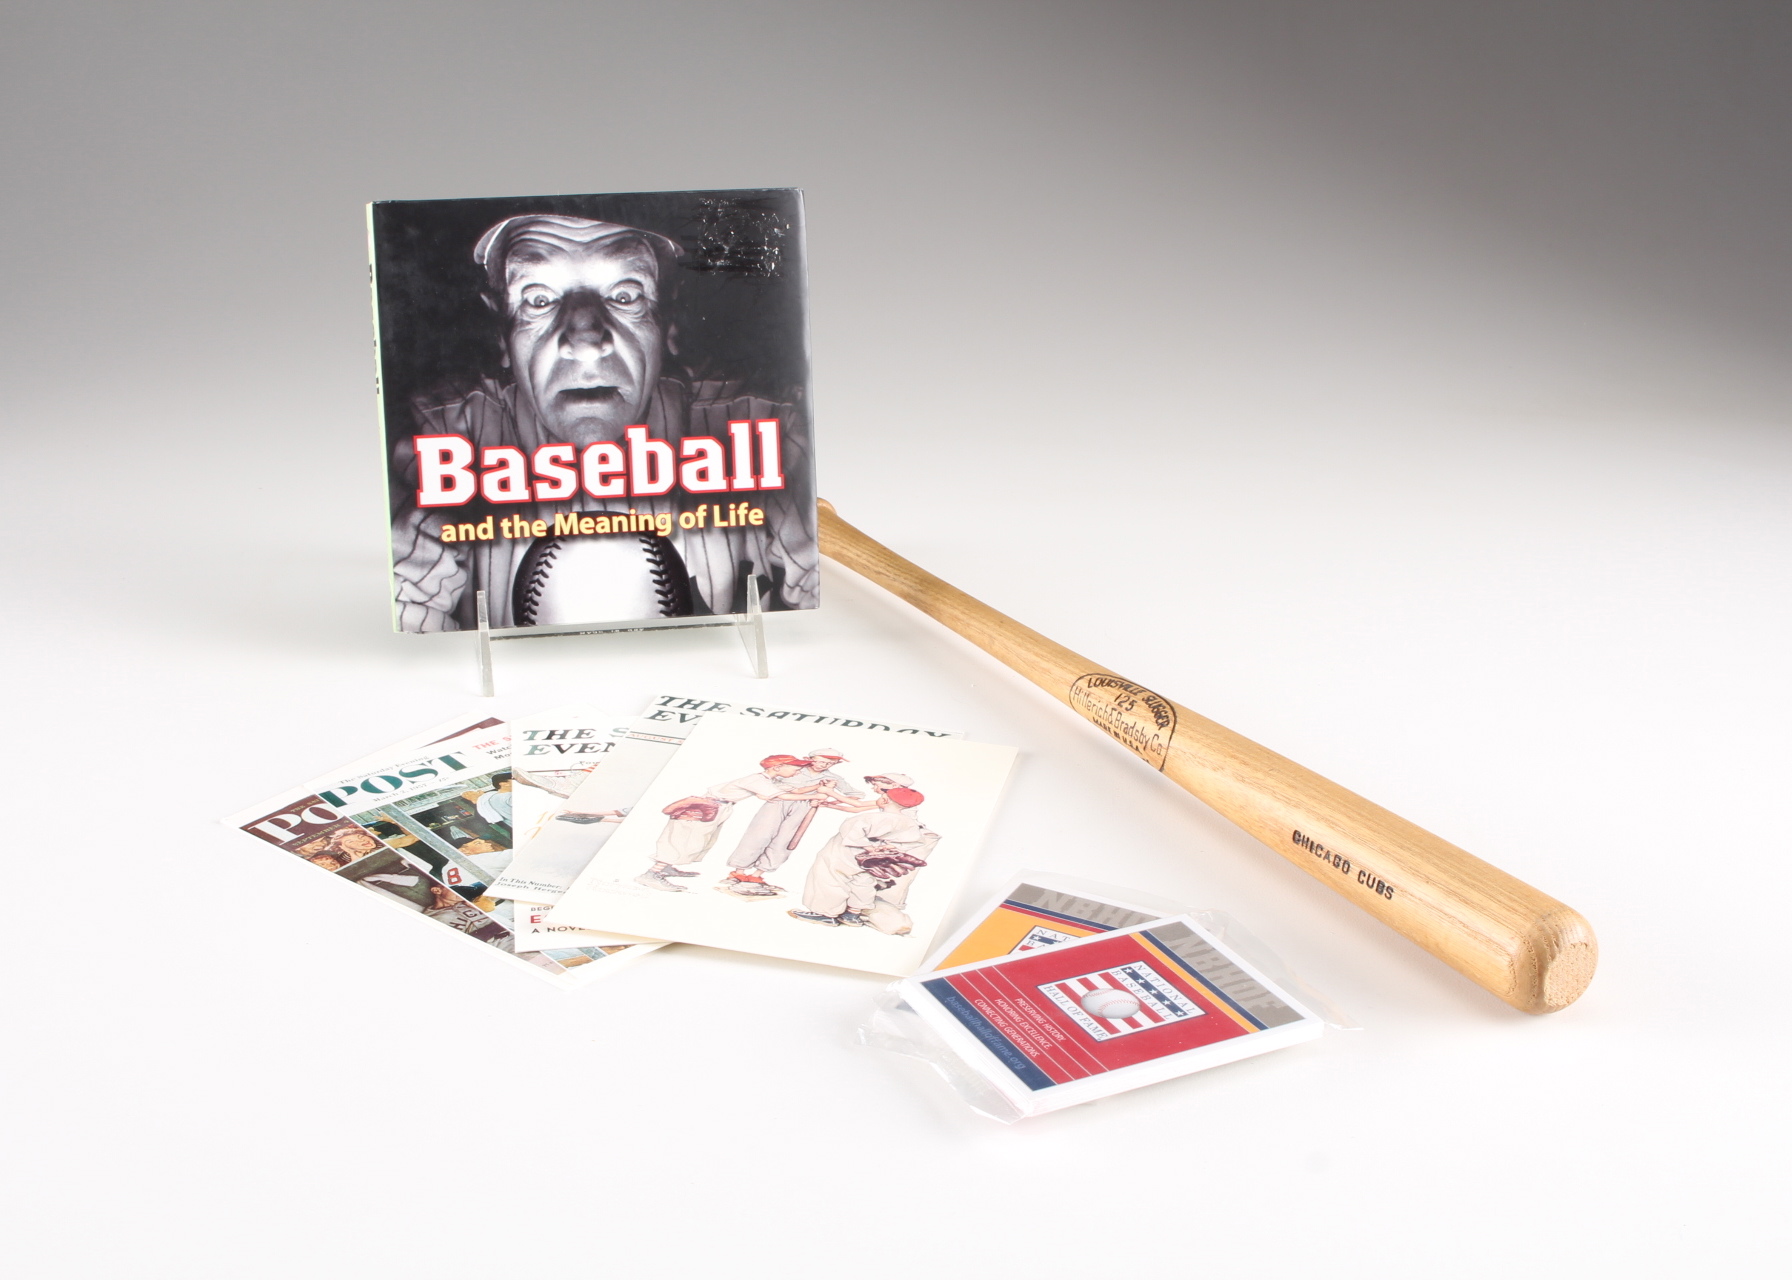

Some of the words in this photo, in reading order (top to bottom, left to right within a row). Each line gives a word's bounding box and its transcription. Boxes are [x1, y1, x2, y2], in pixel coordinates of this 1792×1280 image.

[413, 418, 784, 508] Baseball
[440, 516, 494, 542] and
[500, 514, 547, 538] the
[554, 509, 672, 536] Meaning
[679, 503, 708, 529] of
[713, 502, 764, 528] Life
[655, 695, 732, 713] THE
[1088, 677, 1146, 697] LOUISVILLE
[1142, 695, 1171, 730] SLUGGER
[1114, 693, 1138, 712] 125
[472, 740, 499, 750] THE
[523, 729, 596, 741] THE
[318, 751, 469, 808] POST
[339, 776, 356, 785] The
[358, 765, 395, 779] Saturday
[395, 755, 430, 768] Evening
[373, 791, 399, 802] March
[292, 823, 341, 847] SEPTEMBER
[447, 867, 462, 886] 8
[1292, 829, 1351, 875] CHICAGO
[1357, 869, 1395, 900] CUBS
[496, 882, 529, 890] Joseph
[1164, 934, 1288, 1011] NBHOF
[1111, 969, 1174, 1020] BASEBALL
[1133, 964, 1195, 1014] NATIONAL
[974, 999, 1007, 1028] CONNECTING
[994, 998, 1021, 1023] HONORING
[1015, 998, 1046, 1025] PRESERVING
[1043, 985, 1067, 1007] HALL
[1067, 1005, 1083, 1018] OF
[1081, 1014, 1109, 1040] FAME
[946, 995, 1026, 1070] baseballhalloffame.org
